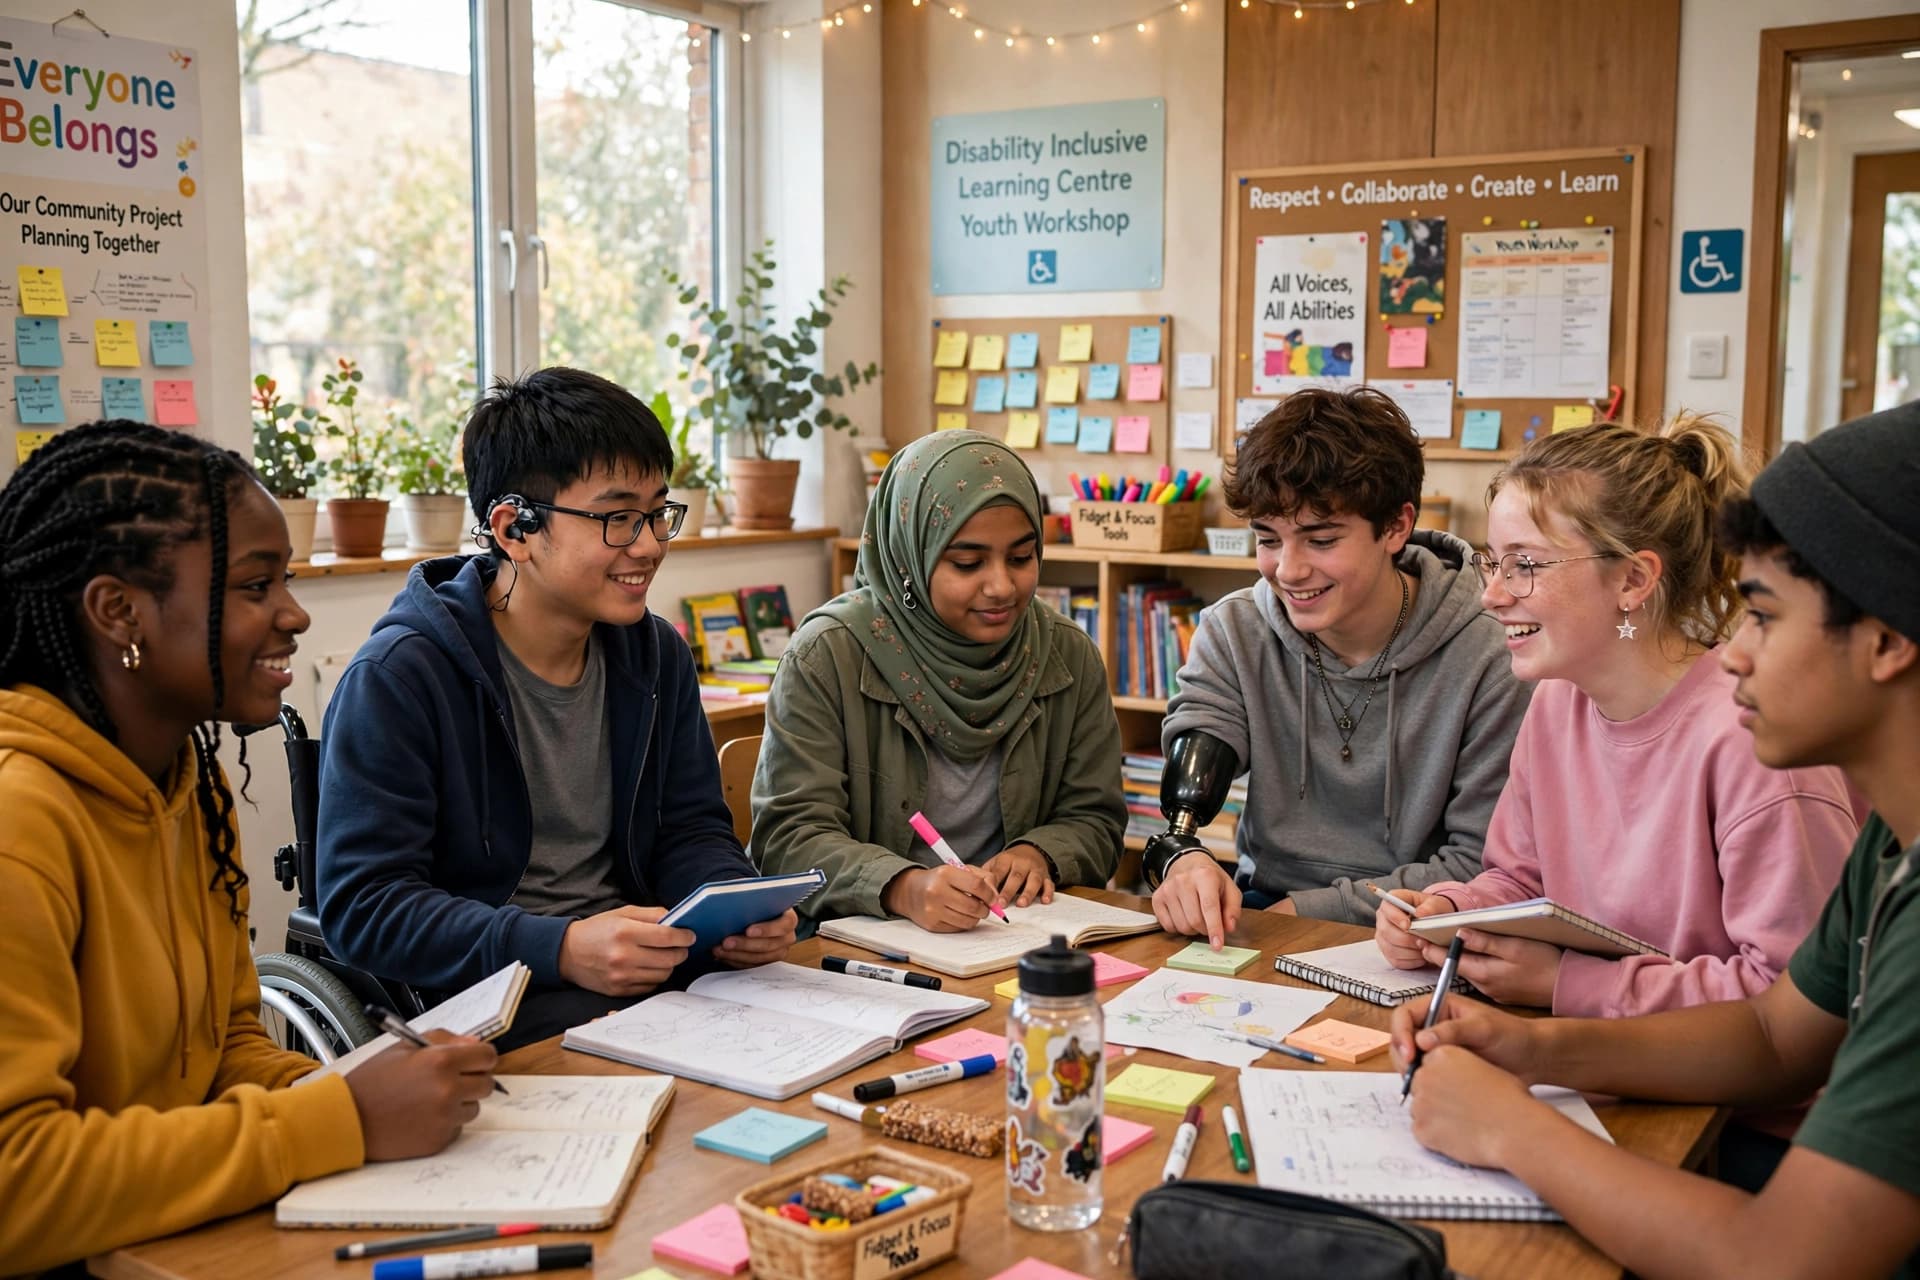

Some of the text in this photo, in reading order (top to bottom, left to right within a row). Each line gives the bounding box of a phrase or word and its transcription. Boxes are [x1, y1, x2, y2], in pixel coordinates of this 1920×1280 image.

[0, 40, 176, 111] Everyone
[0, 97, 158, 169] Belongs
[946, 129, 1148, 165] Disability Inclusive
[959, 169, 1132, 201] Learning Centre
[1249, 170, 1619, 214] Respect Collaborate Create Learn
[0, 192, 183, 231] Our Community Project
[960, 207, 1130, 238] Youth Workshop
[21, 224, 161, 256] Planning Together
[1270, 273, 1353, 295] All Voices,
[1264, 299, 1355, 321] All Abilities
[1079, 508, 1156, 526] Fidget & Focus
[1102, 527, 1129, 541] Tools
[863, 1213, 952, 1261] Fidget & Focus
